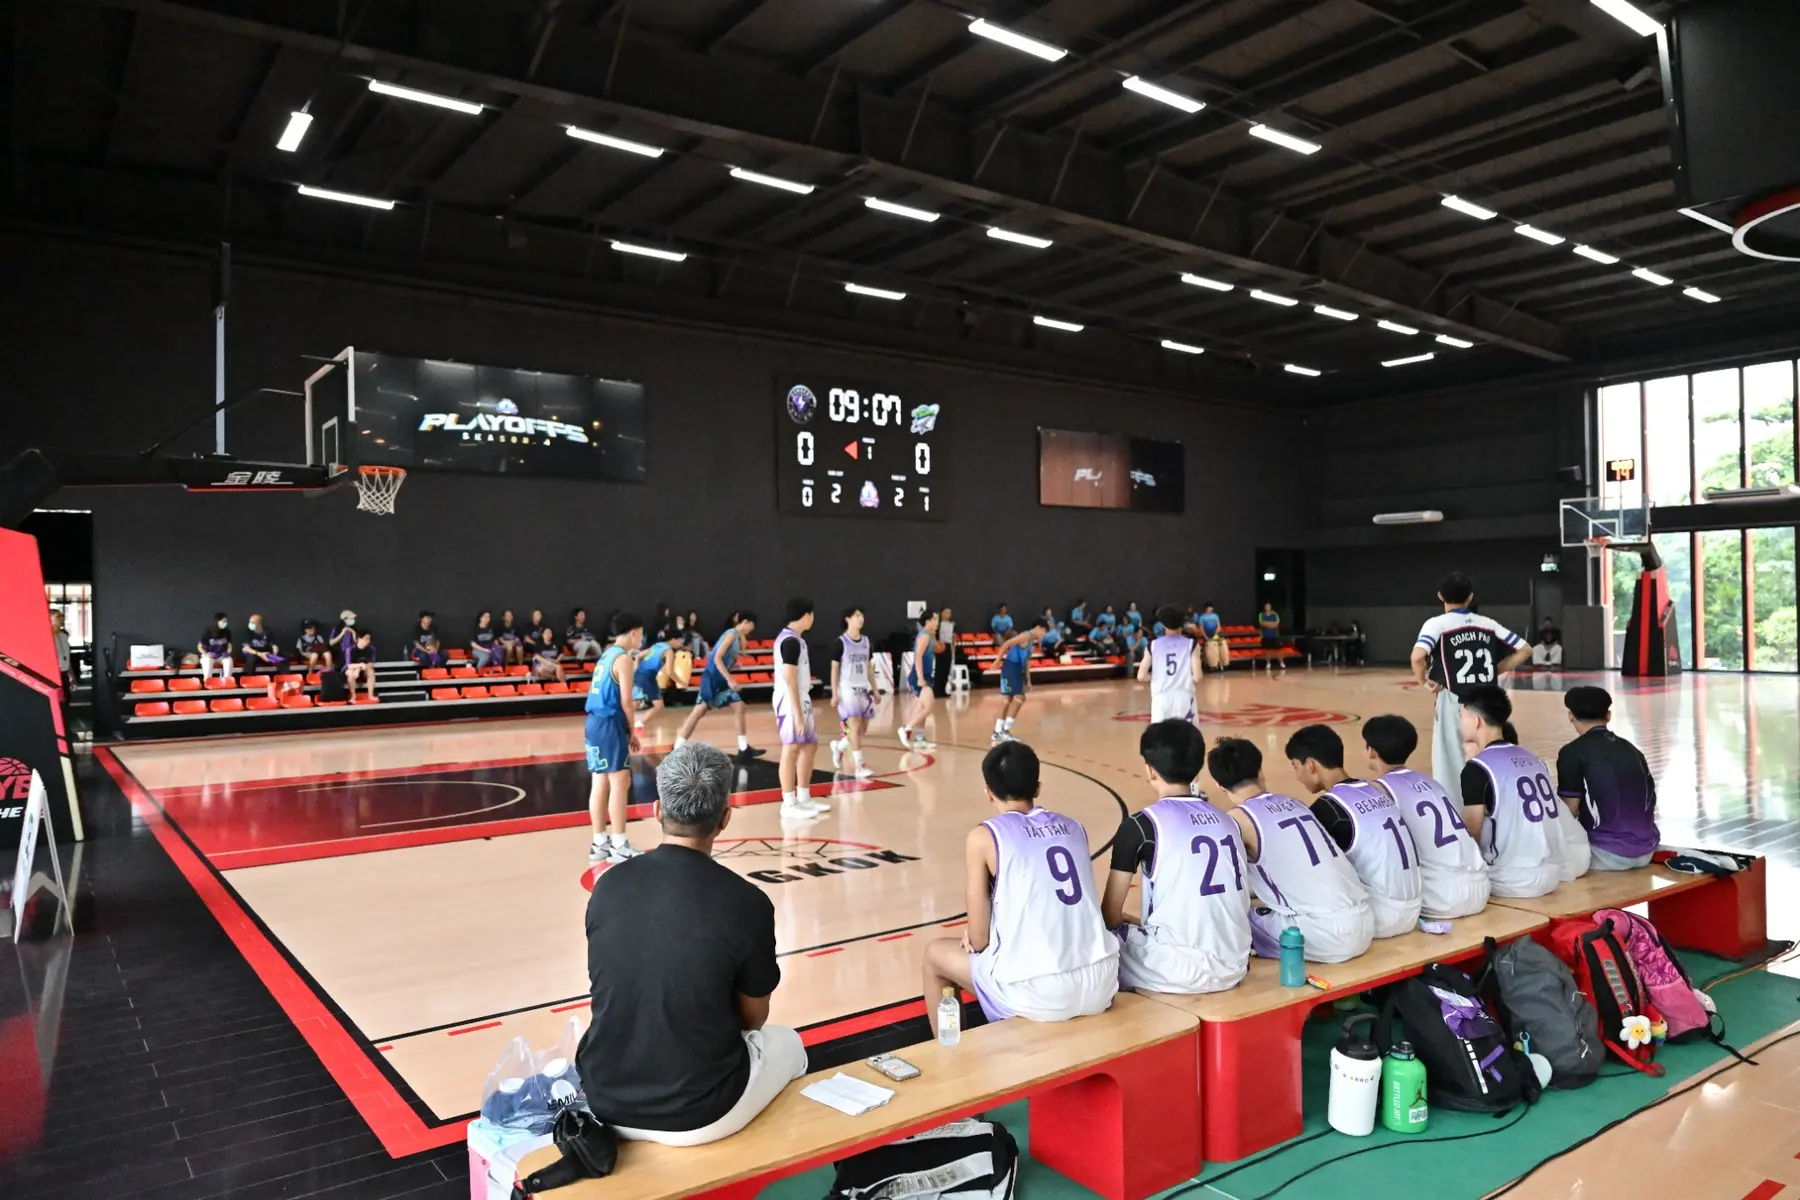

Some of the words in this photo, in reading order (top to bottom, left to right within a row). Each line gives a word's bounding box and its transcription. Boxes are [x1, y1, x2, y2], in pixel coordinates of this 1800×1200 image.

[828, 387, 902, 427] 09:07
[418, 412, 590, 444] PLAYOFFS
[797, 431, 815, 466] 0
[866, 445, 873, 460] 1
[915, 442, 931, 475] 0
[802, 486, 813, 508] 0
[830, 482, 842, 504] 2
[893, 486, 905, 508] 2
[923, 495, 930, 512] 1
[1450, 631, 1477, 647] COACH
[1165, 652, 1178, 677] 5
[1454, 647, 1494, 684] 23
[1516, 772, 1558, 823] 89
[1188, 811, 1220, 827] ACHI
[1415, 796, 1475, 849] 24
[1277, 814, 1338, 867] 77
[1045, 844, 1084, 906] 9
[1190, 833, 1244, 897] 21
